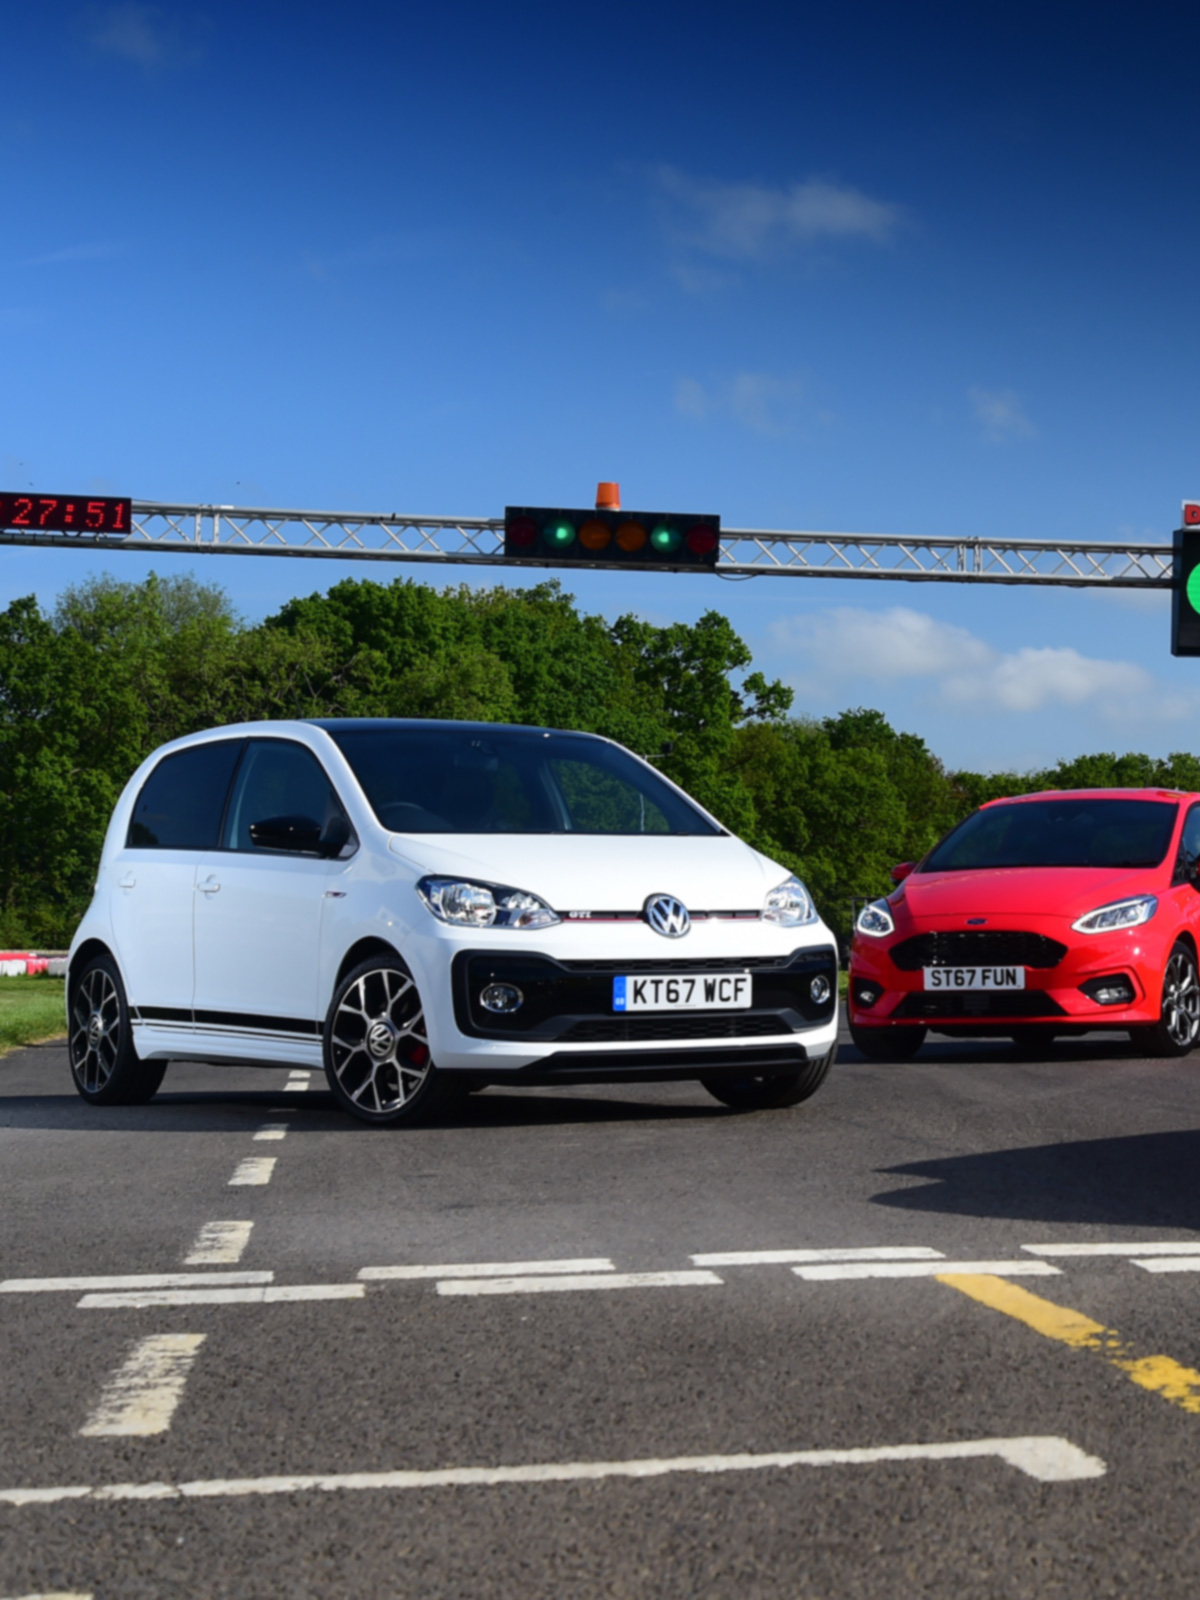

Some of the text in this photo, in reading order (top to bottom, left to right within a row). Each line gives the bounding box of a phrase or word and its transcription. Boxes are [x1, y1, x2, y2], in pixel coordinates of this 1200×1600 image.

[930, 968, 1017, 987] ST67 FUN
[632, 977, 748, 1004] KT67 WCF
